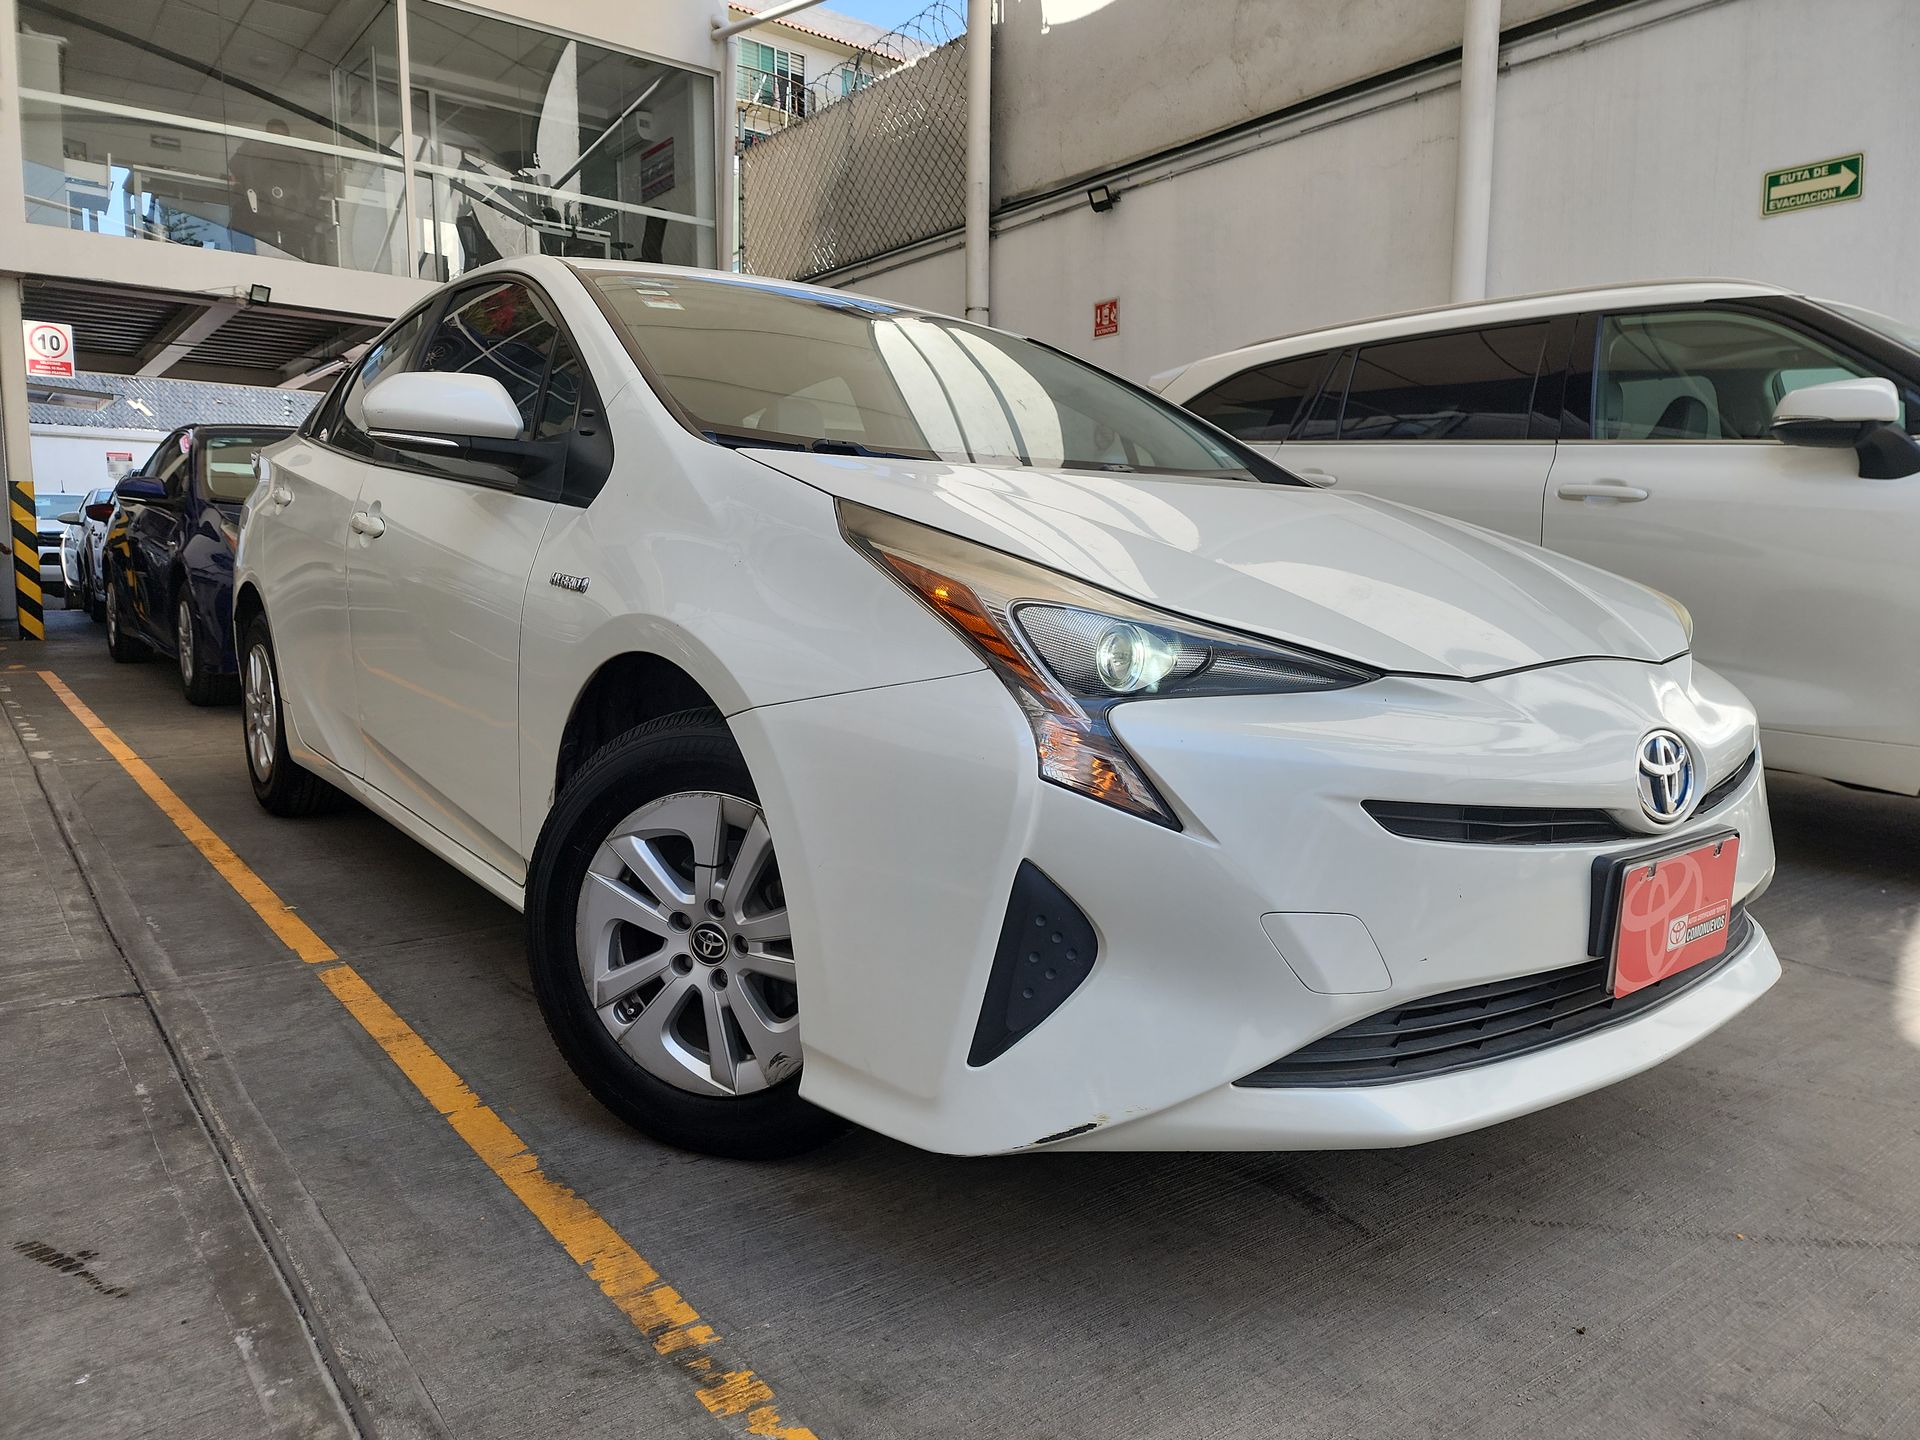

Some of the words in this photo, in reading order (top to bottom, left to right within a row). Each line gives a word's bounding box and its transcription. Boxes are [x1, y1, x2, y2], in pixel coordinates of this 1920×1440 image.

[1779, 170, 1810, 185] RUTA
[1813, 165, 1829, 178] DE
[1768, 188, 1837, 210] EVACUACION
[37, 333, 61, 351] 10
